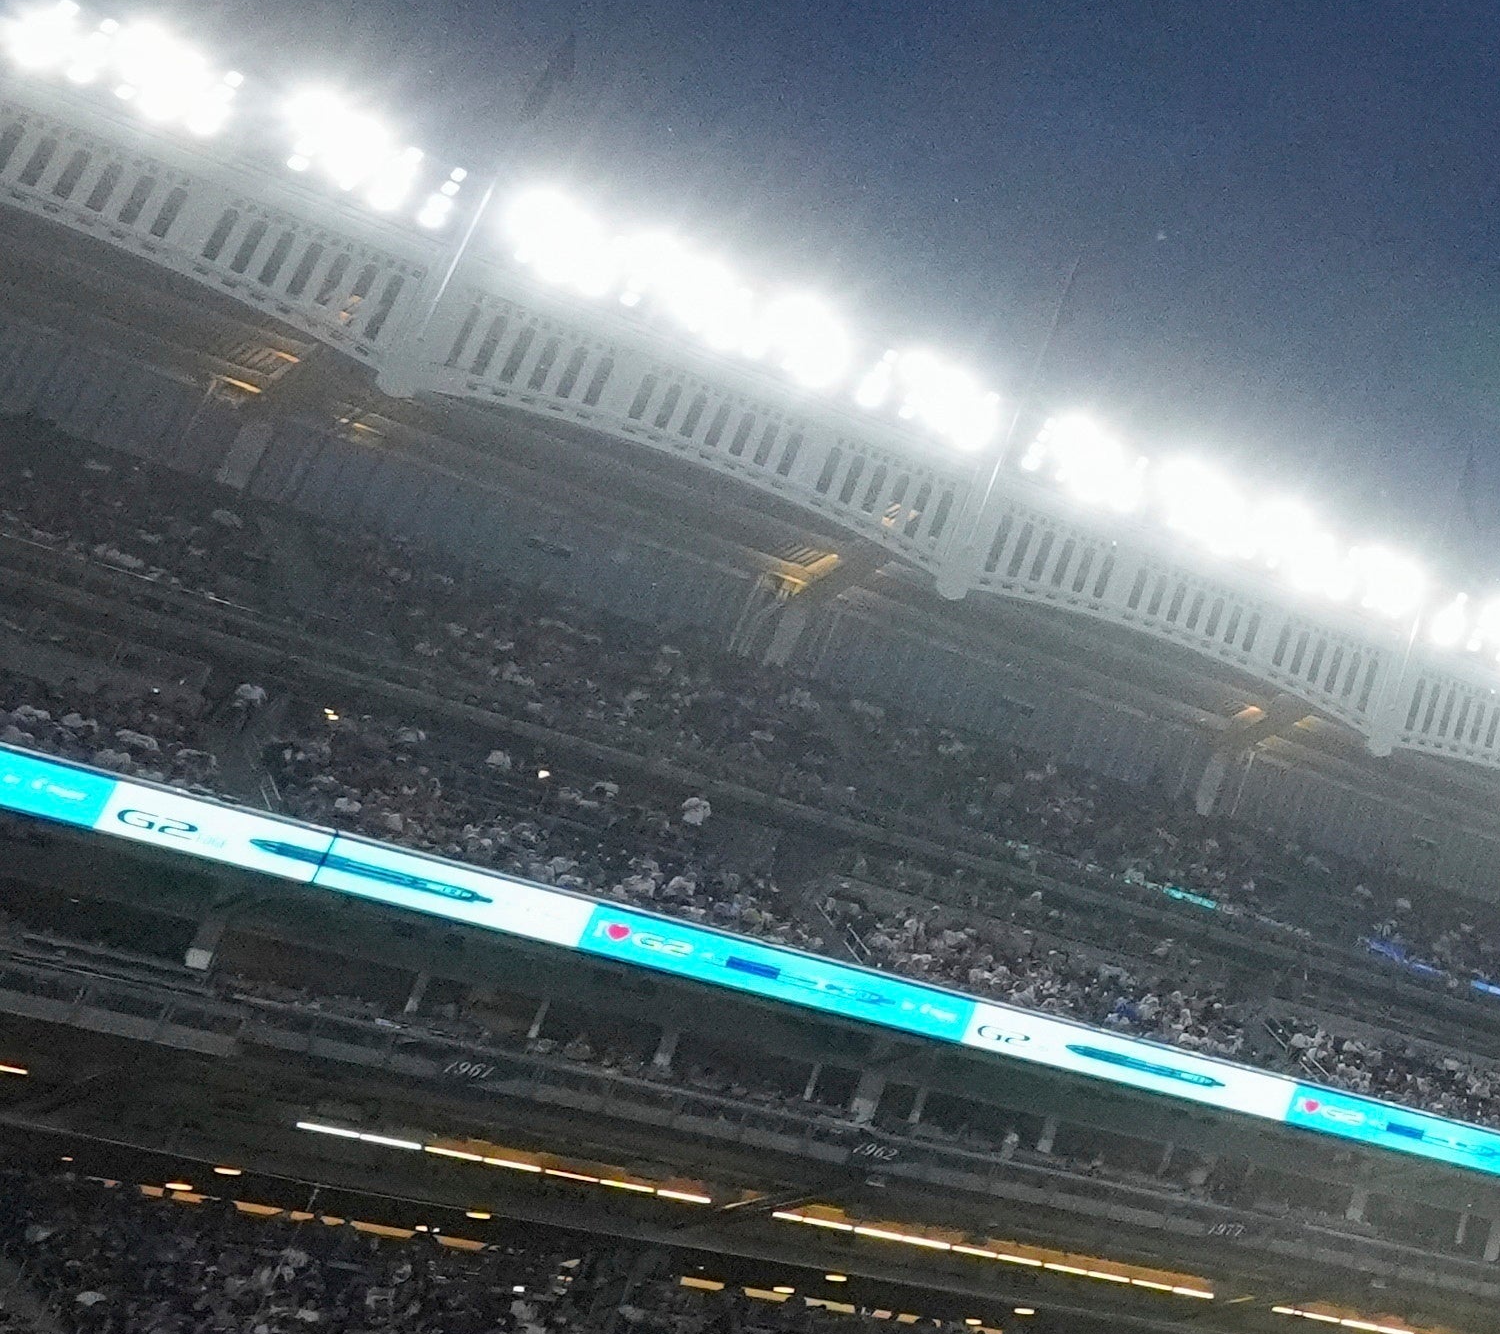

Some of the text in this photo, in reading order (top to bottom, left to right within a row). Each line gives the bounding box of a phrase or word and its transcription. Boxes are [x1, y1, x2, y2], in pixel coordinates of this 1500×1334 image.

[117, 809, 198, 840] G2
[632, 932, 694, 956] G2
[444, 1060, 497, 1078] 1961
[852, 1142, 898, 1160] 1962
